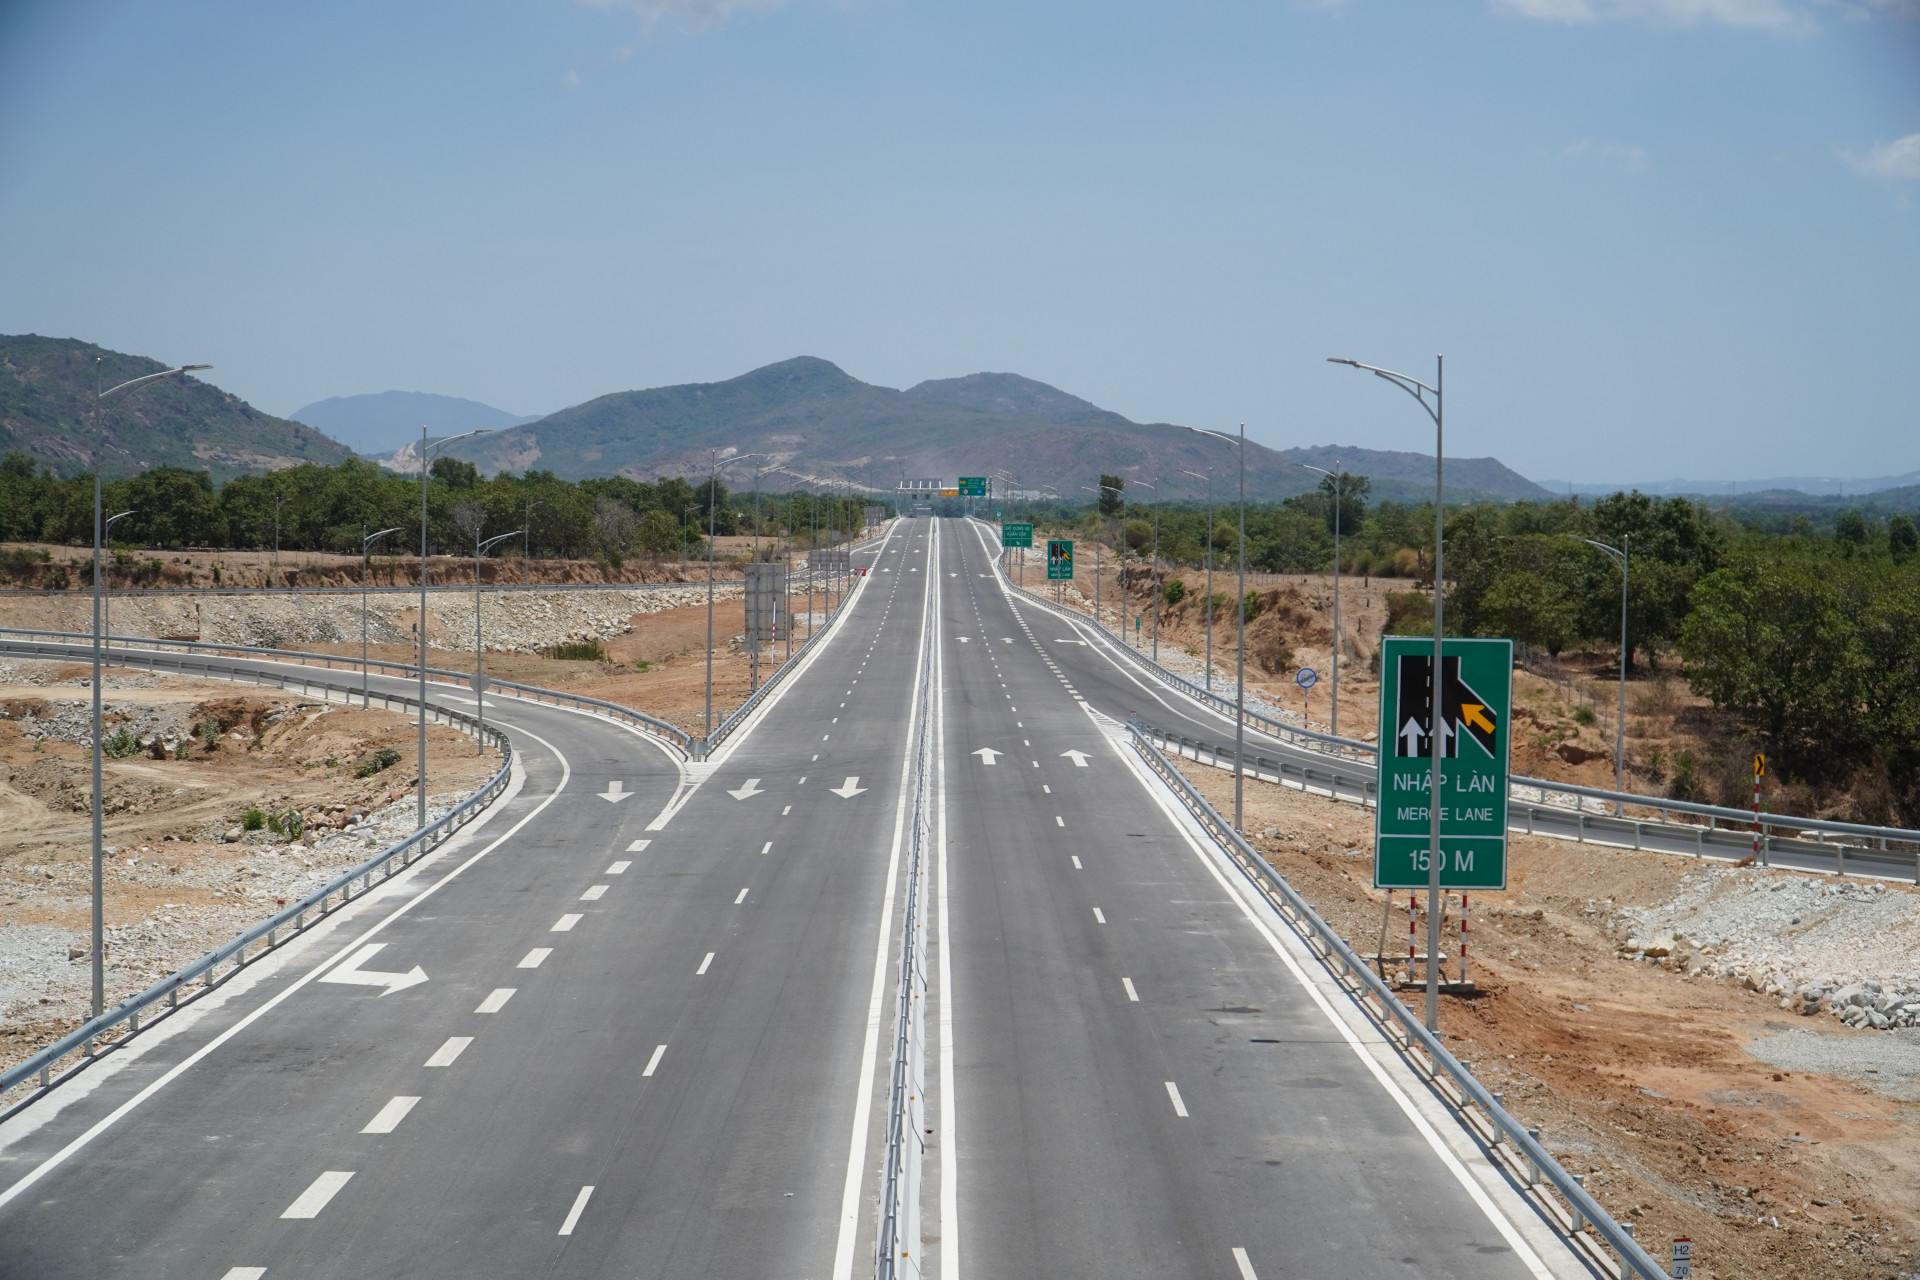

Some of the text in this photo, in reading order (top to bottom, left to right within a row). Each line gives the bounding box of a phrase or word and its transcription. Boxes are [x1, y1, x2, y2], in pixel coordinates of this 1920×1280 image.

[1456, 770, 1495, 793] LÀN
[1397, 807, 1493, 821] MERE LANE
[1455, 850, 1474, 872] M
[1674, 1245, 1689, 1255] H2
[1675, 1266, 1688, 1275] 70
